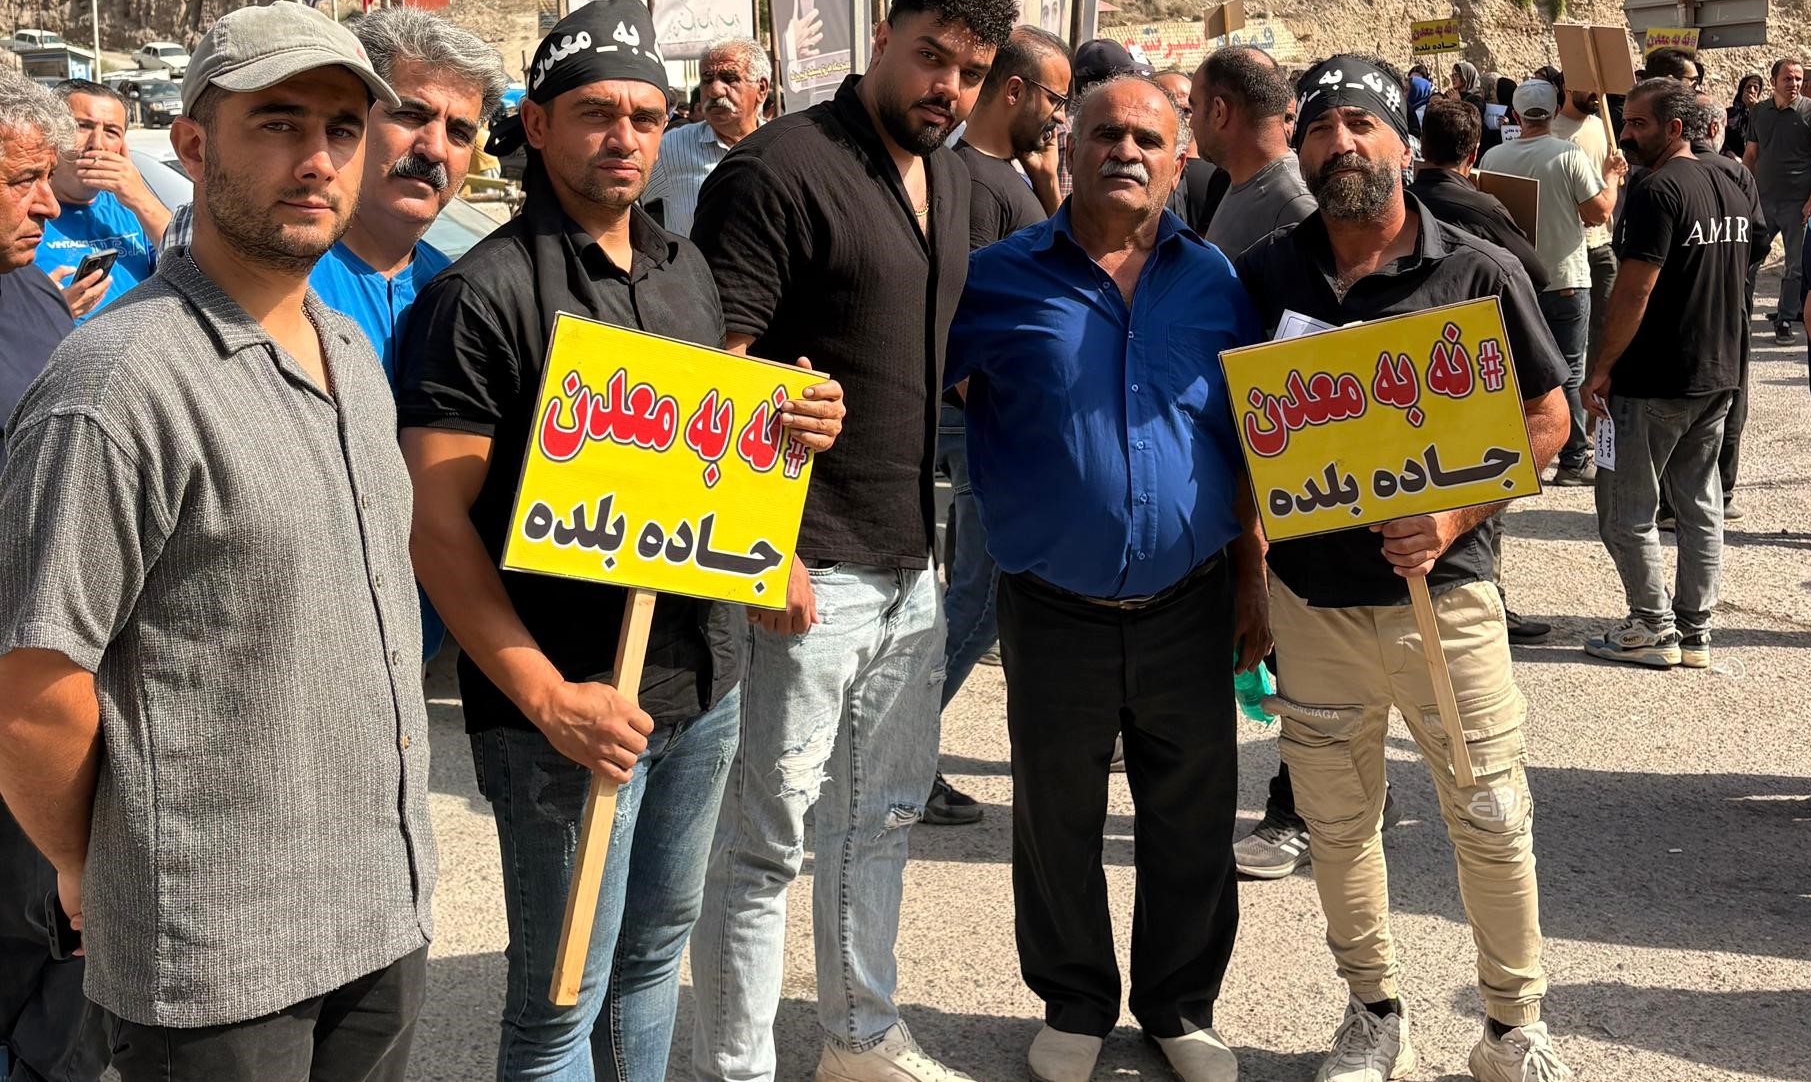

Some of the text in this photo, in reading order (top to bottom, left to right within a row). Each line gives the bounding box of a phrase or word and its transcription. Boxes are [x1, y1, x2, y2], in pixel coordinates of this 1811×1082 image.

[1681, 216, 1749, 247] AMIR
[539, 368, 678, 462] معدن
[1244, 369, 1367, 457] معدن
[1372, 352, 1424, 428] به
[685, 389, 733, 487] به
[1268, 443, 1520, 516] جاده بلده
[524, 494, 784, 593] جاده بلده
